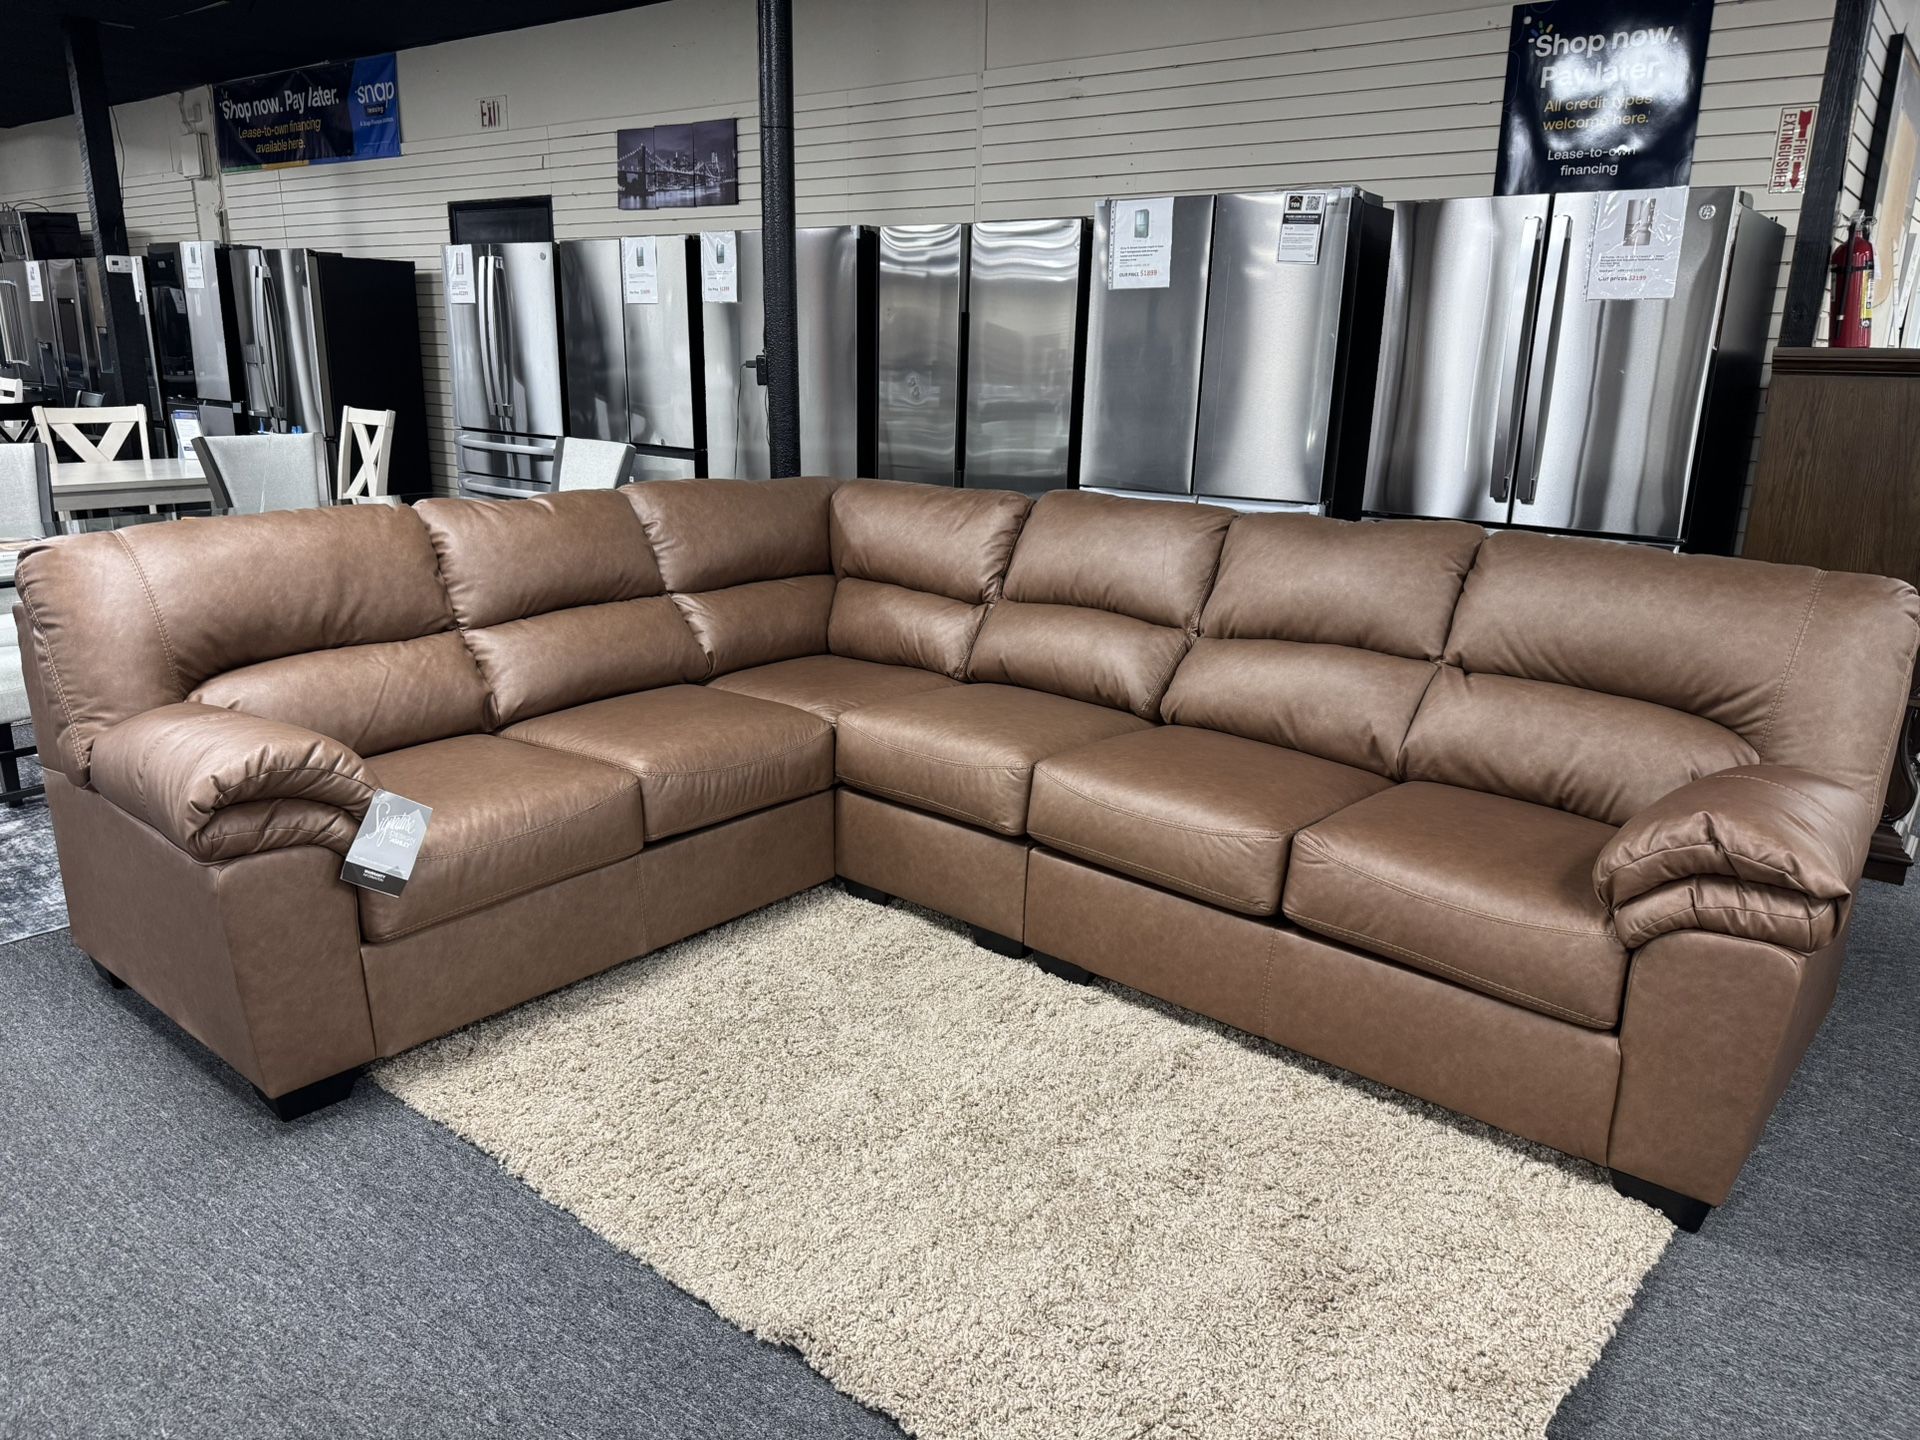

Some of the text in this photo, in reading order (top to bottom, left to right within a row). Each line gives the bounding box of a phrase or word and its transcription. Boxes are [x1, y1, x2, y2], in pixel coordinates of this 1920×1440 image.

[1534, 26, 1679, 58] Shop now.
[1540, 61, 1665, 90] Pay later.
[221, 86, 339, 123] Shop now. Pay later.
[357, 82, 395, 108] snap
[1544, 95, 1653, 113] All credit types
[238, 117, 321, 139] Lease-to-own financing
[1543, 116, 1609, 131] welcome
[256, 137, 306, 153] available here.
[1547, 145, 1636, 161] Lease-to-own
[1773, 113, 1797, 188] EXTINGUISHER
[1792, 138, 1808, 161] FIRE
[1560, 162, 1619, 177] financing
